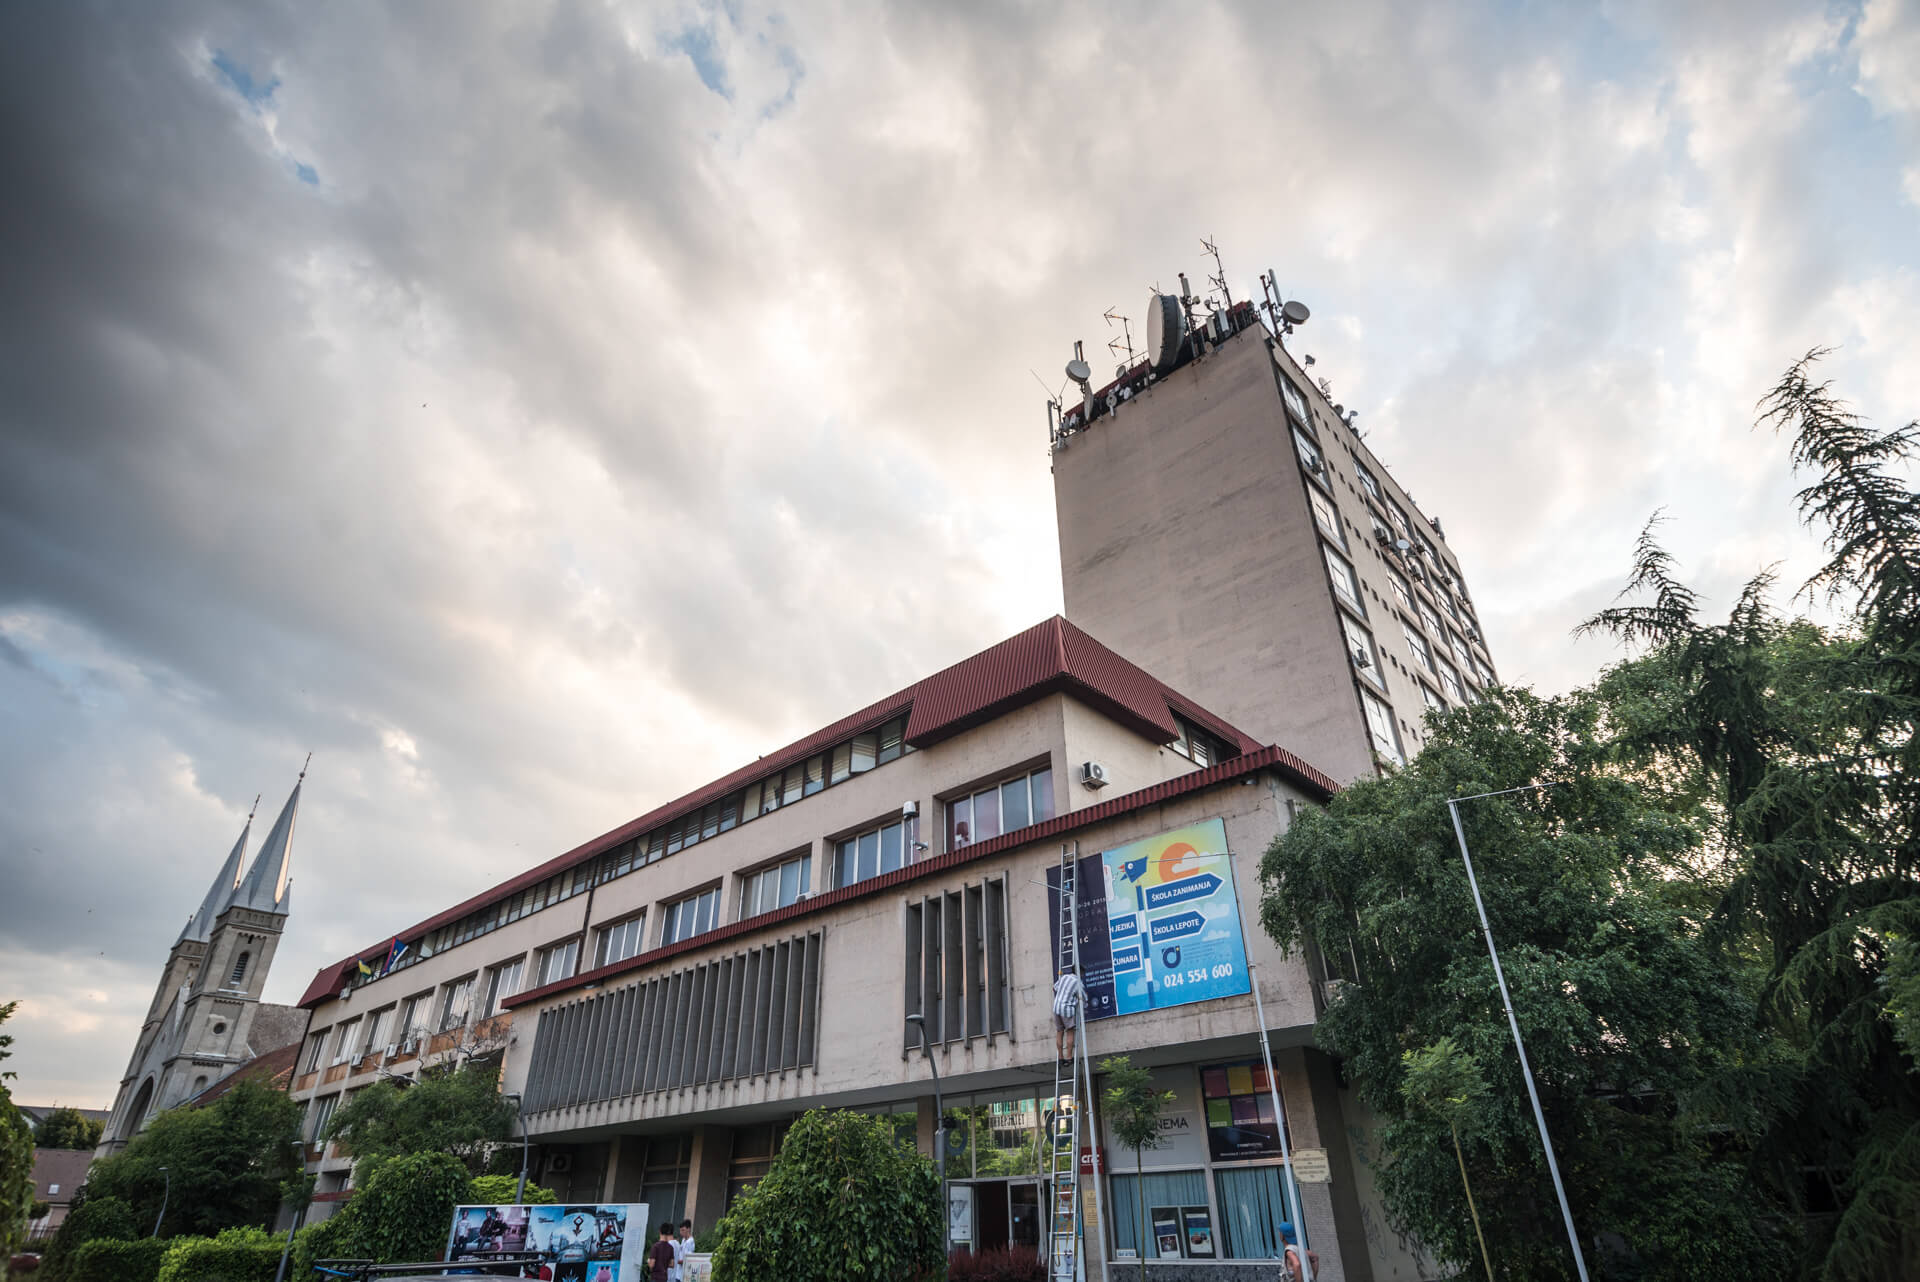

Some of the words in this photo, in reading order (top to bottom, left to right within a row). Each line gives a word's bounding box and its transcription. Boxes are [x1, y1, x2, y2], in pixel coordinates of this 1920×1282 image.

[1151, 890, 1172, 902] ŠKOLA
[1173, 881, 1212, 897] ZANIMANJA
[1115, 921, 1135, 933] JEZIKA
[1153, 924, 1174, 936] ŠKOLA
[1175, 918, 1200, 931] LEPOTE
[1164, 972, 1184, 988] 024
[1187, 967, 1209, 983] 554
[1212, 962, 1233, 979] 600
[1154, 1117, 1189, 1130] NEMA
